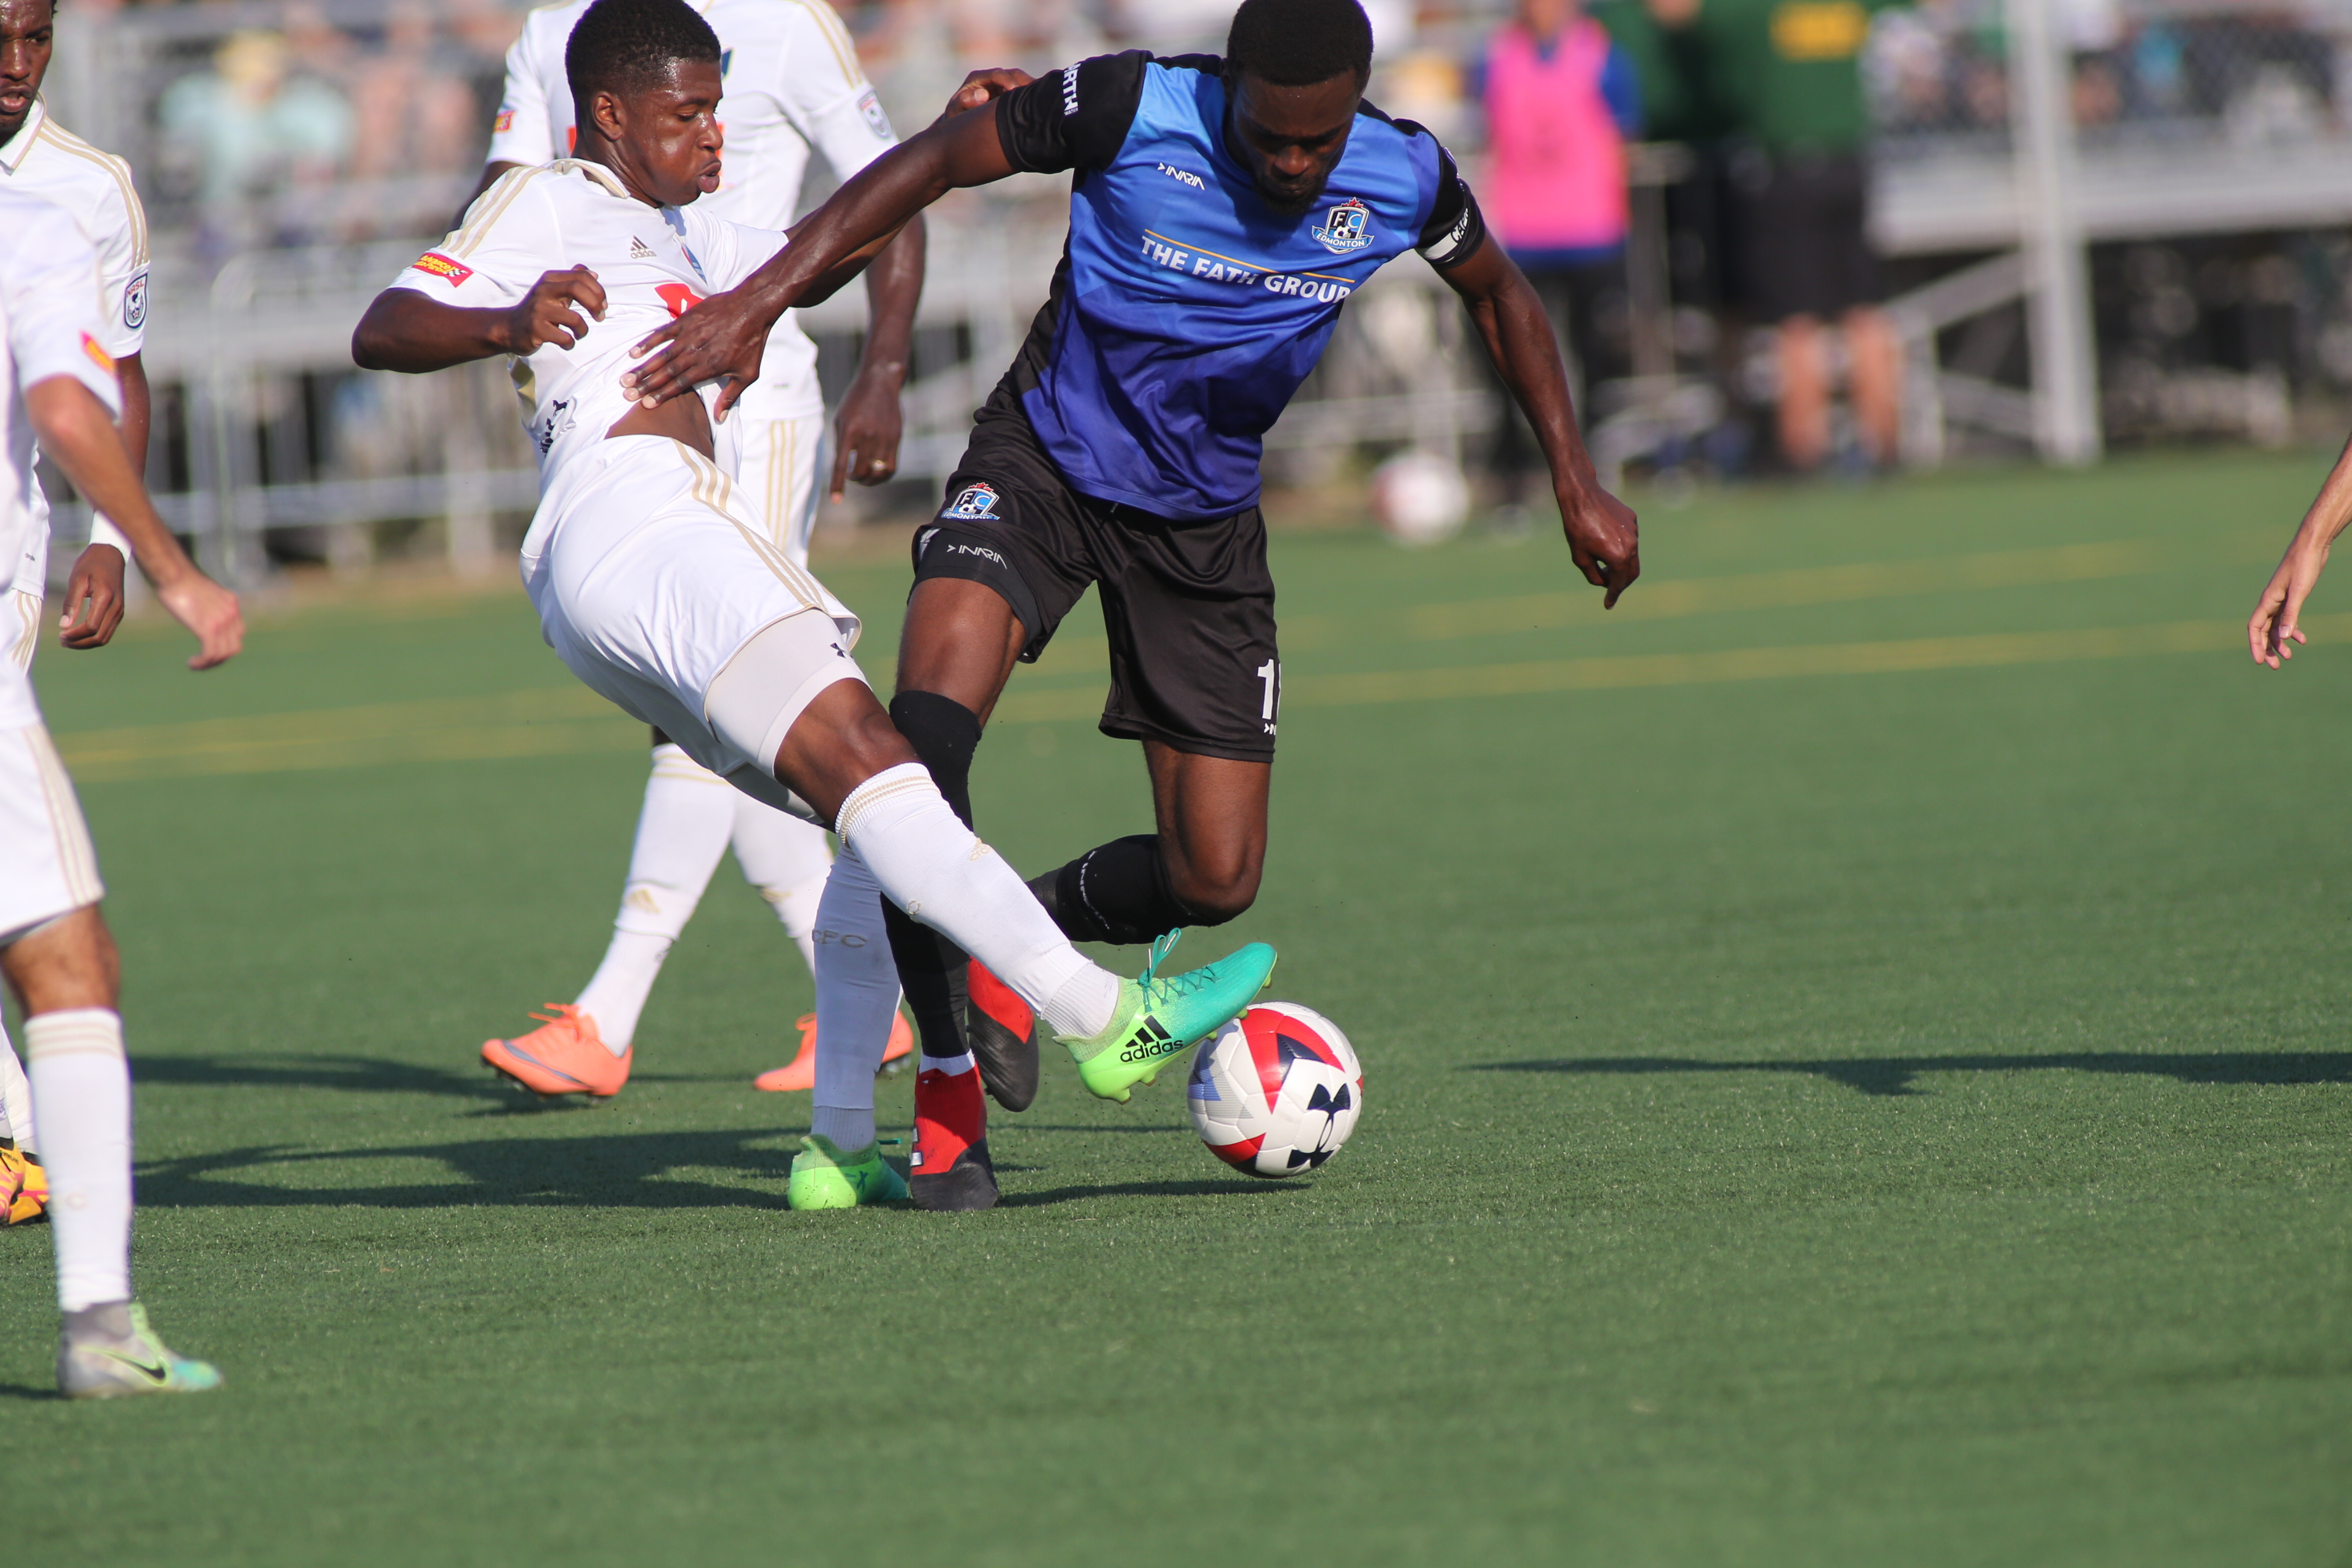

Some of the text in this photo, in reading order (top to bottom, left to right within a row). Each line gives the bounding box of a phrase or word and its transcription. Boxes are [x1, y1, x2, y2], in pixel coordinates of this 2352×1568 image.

[1064, 107, 1079, 116] WATER
[1316, 233, 1365, 248] EDMONTON
[630, 249, 657, 259] adidas
[1142, 235, 1351, 303] THE FATH GROUP
[127, 279, 144, 295] NASL
[1257, 658, 1281, 720] 1
[1120, 1040, 1184, 1062] adidas
